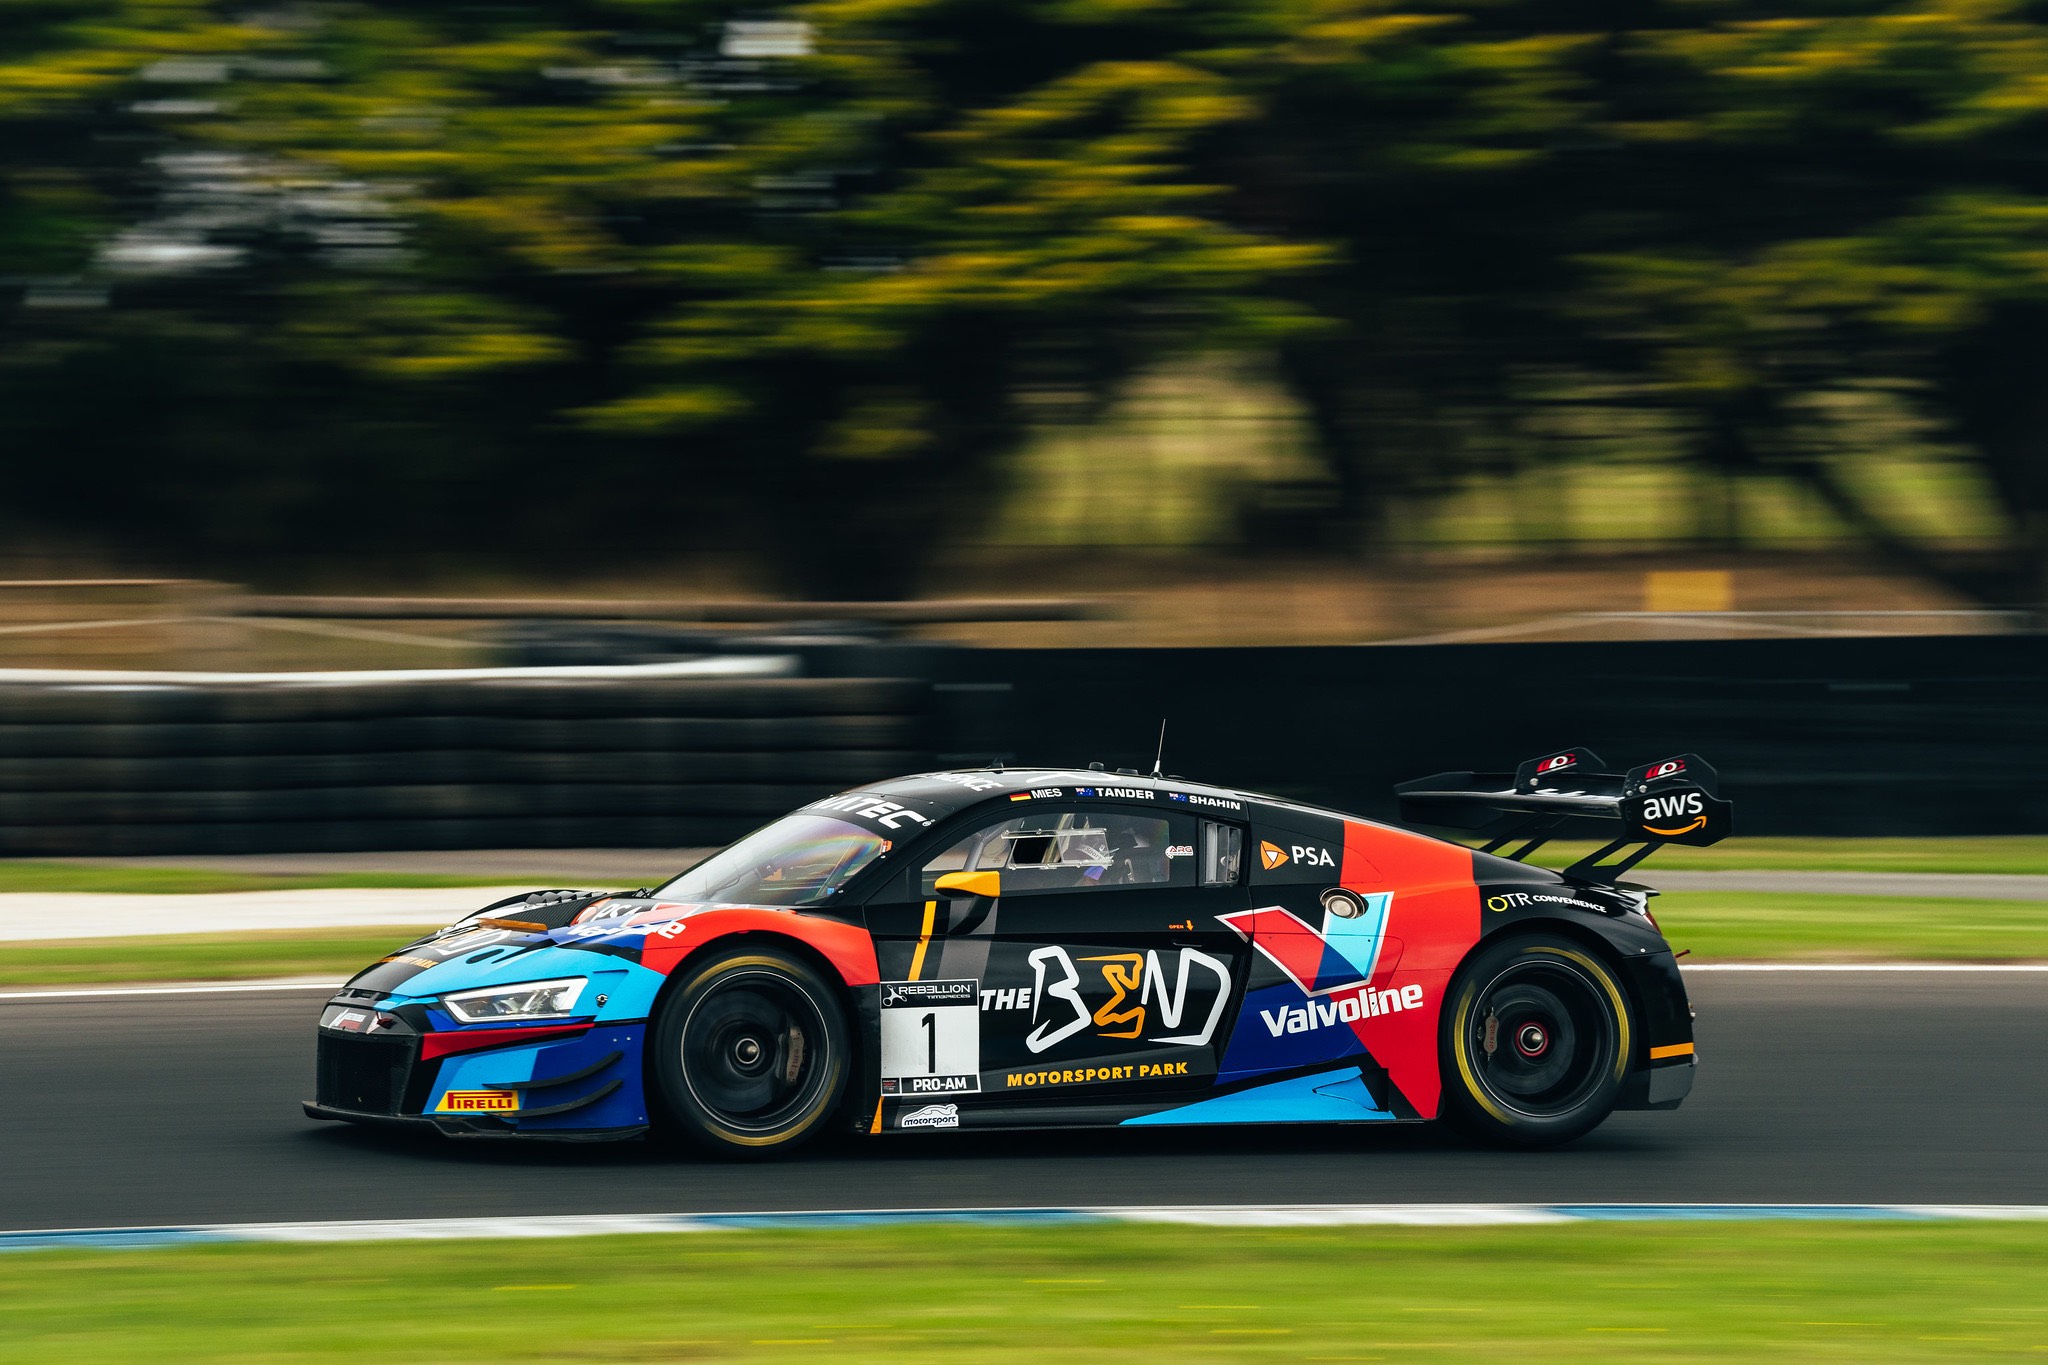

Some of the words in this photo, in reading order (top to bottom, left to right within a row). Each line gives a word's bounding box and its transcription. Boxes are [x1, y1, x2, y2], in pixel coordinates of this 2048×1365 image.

[1031, 788, 1063, 799] MIES
[1095, 787, 1155, 800] TANDER
[1189, 795, 1241, 811] SHAHIN
[1643, 792, 1704, 820] aws
[1291, 845, 1336, 867] PSA
[1487, 892, 1533, 912] OTR
[1533, 895, 1607, 913] CONVENIENCE
[898, 984, 971, 995] REBELLION
[980, 987, 1032, 1011] THE
[1260, 983, 1424, 1038] Valvoline
[921, 1012, 936, 1074] 1
[1007, 1066, 1134, 1087] MOTORSPORT
[1139, 1061, 1188, 1077] PARK
[912, 1077, 967, 1092] PRO-AM
[447, 1091, 513, 1109] PIRELLI
[904, 1116, 957, 1126] motorsport
